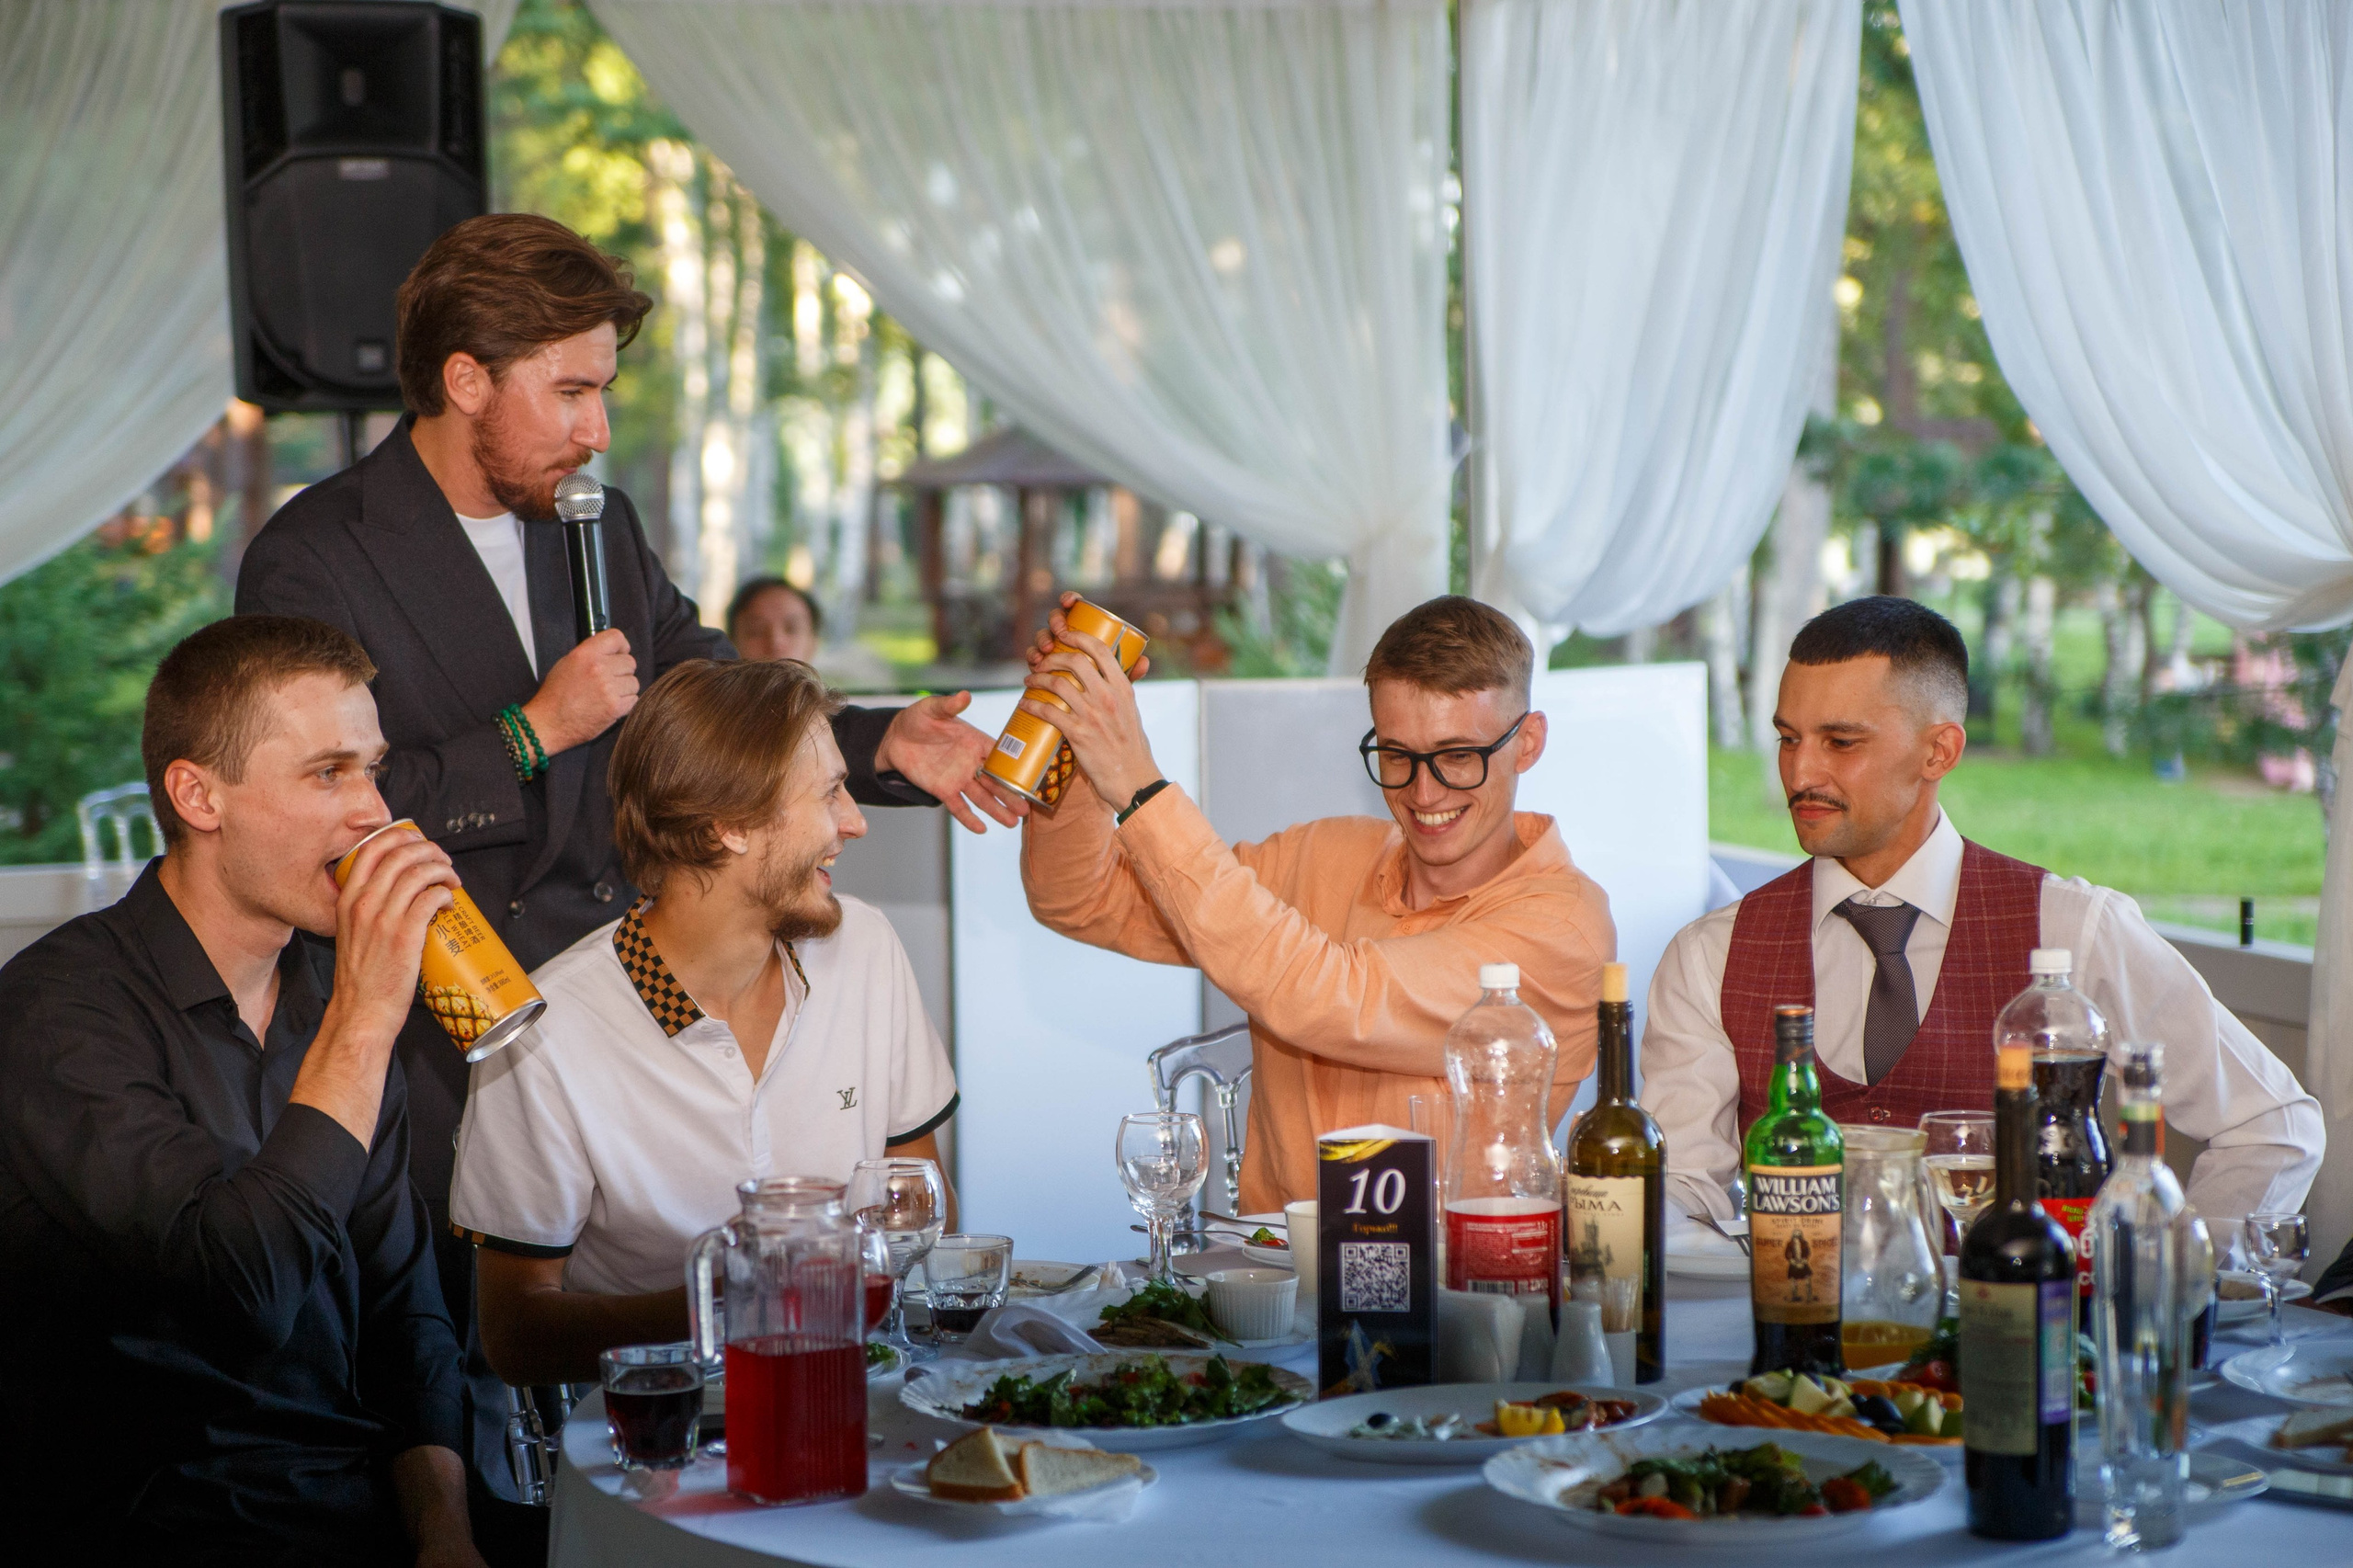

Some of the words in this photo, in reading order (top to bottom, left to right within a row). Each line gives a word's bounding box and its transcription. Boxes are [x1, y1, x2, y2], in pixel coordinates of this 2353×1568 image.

[458, 905, 474, 925] CRAFT
[472, 924, 486, 941] BEER
[450, 924, 472, 949] WHEAT
[1343, 1168, 1406, 1215] 10
[1754, 1176, 1836, 1195] WILLIAM
[1752, 1194, 1840, 1213] LAWSON'S
